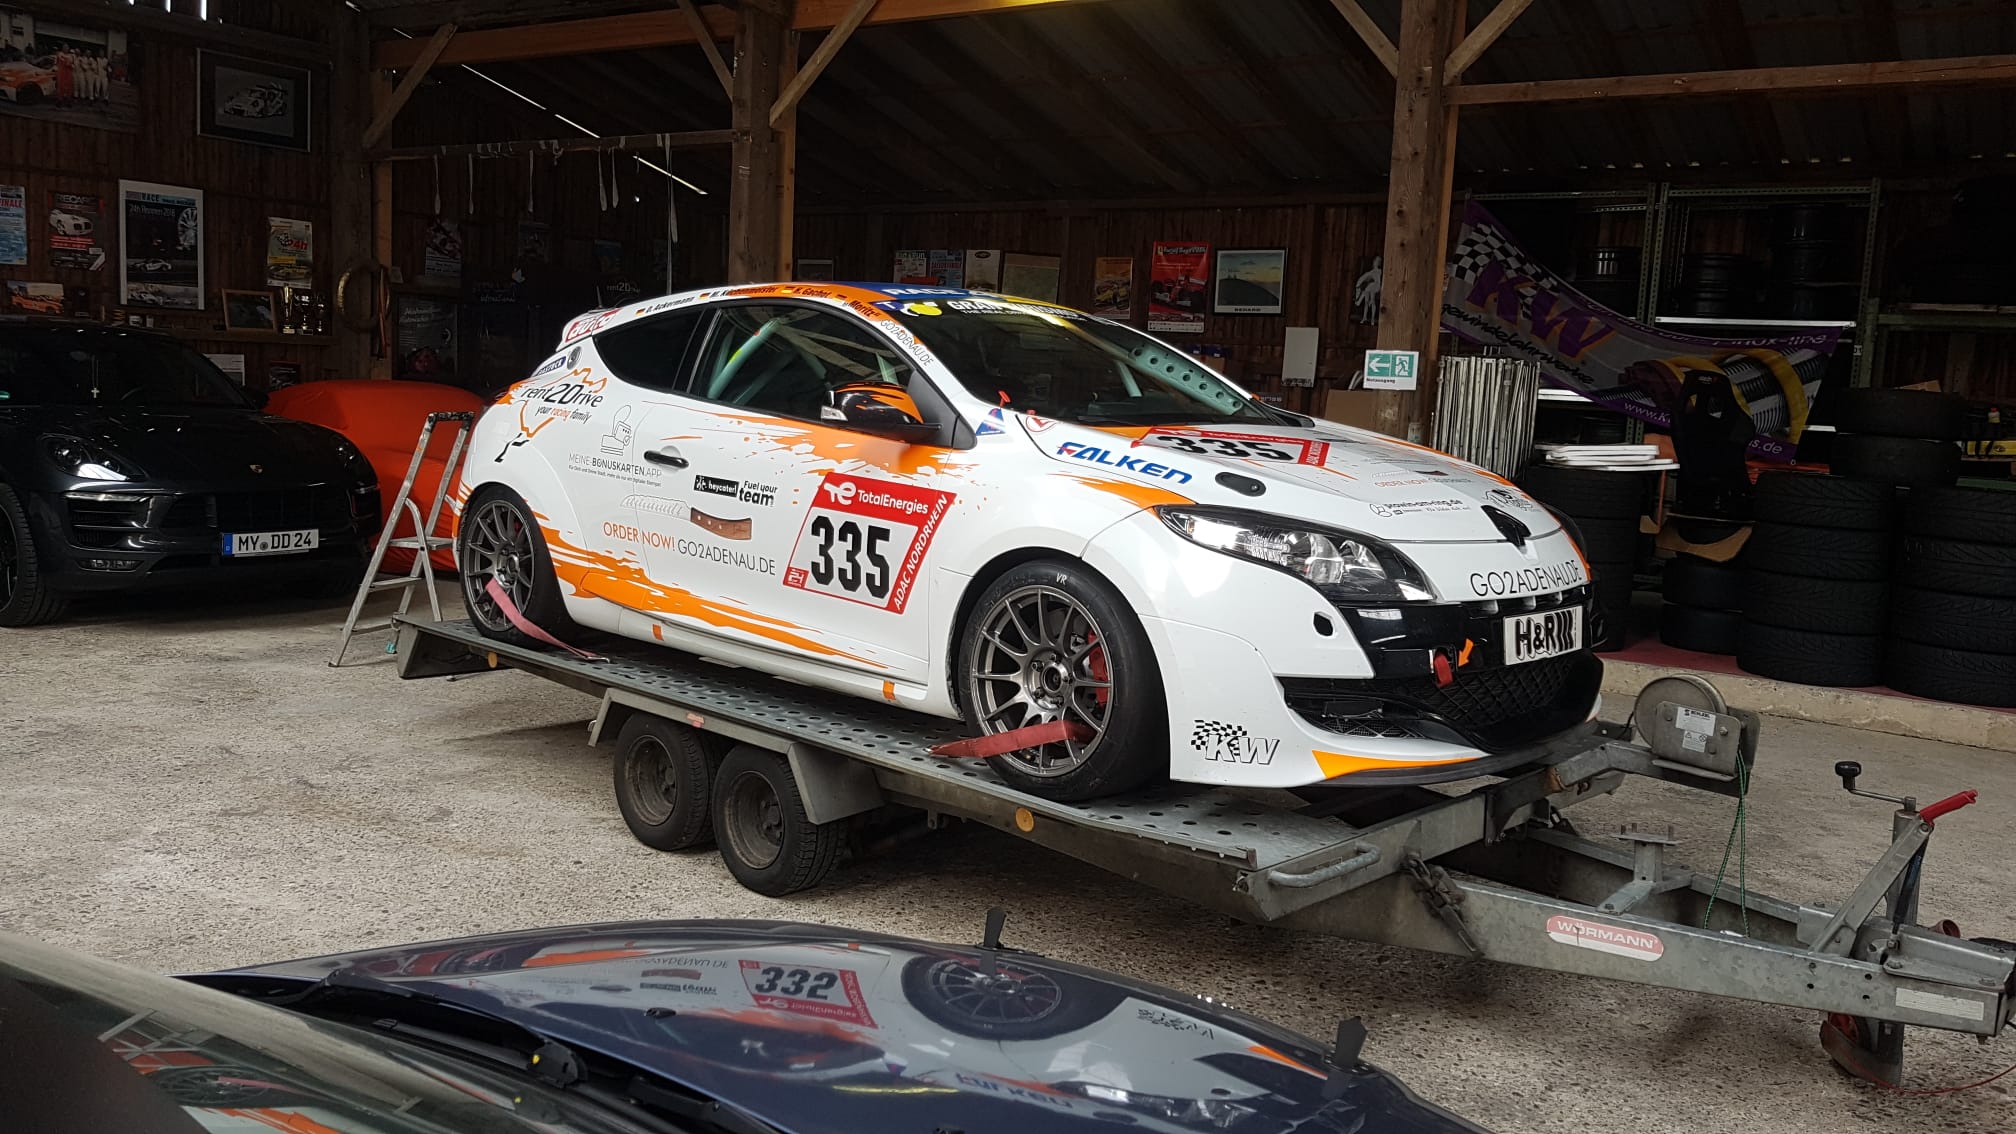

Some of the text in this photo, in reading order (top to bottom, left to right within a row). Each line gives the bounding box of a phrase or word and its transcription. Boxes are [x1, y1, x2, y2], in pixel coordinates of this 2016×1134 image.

[1466, 258, 1618, 363] KW
[520, 384, 604, 408] rent2Drive
[1056, 441, 1193, 485] FALKEN
[1157, 435, 1294, 461] 335
[739, 487, 775, 507] team
[743, 480, 778, 493] Fuel your
[857, 489, 929, 514] TotalEnergies
[238, 532, 312, 551] MY DD 24
[603, 521, 776, 576] ORDER NOW! GO2ADENAU.DE
[893, 494, 948, 610] ADAC NORDRHEIN
[811, 515, 891, 600] 335
[1469, 559, 1583, 597] GO2ADENAU.DE
[1205, 733, 1280, 765] KW
[1556, 919, 1655, 949] WÖRMANN
